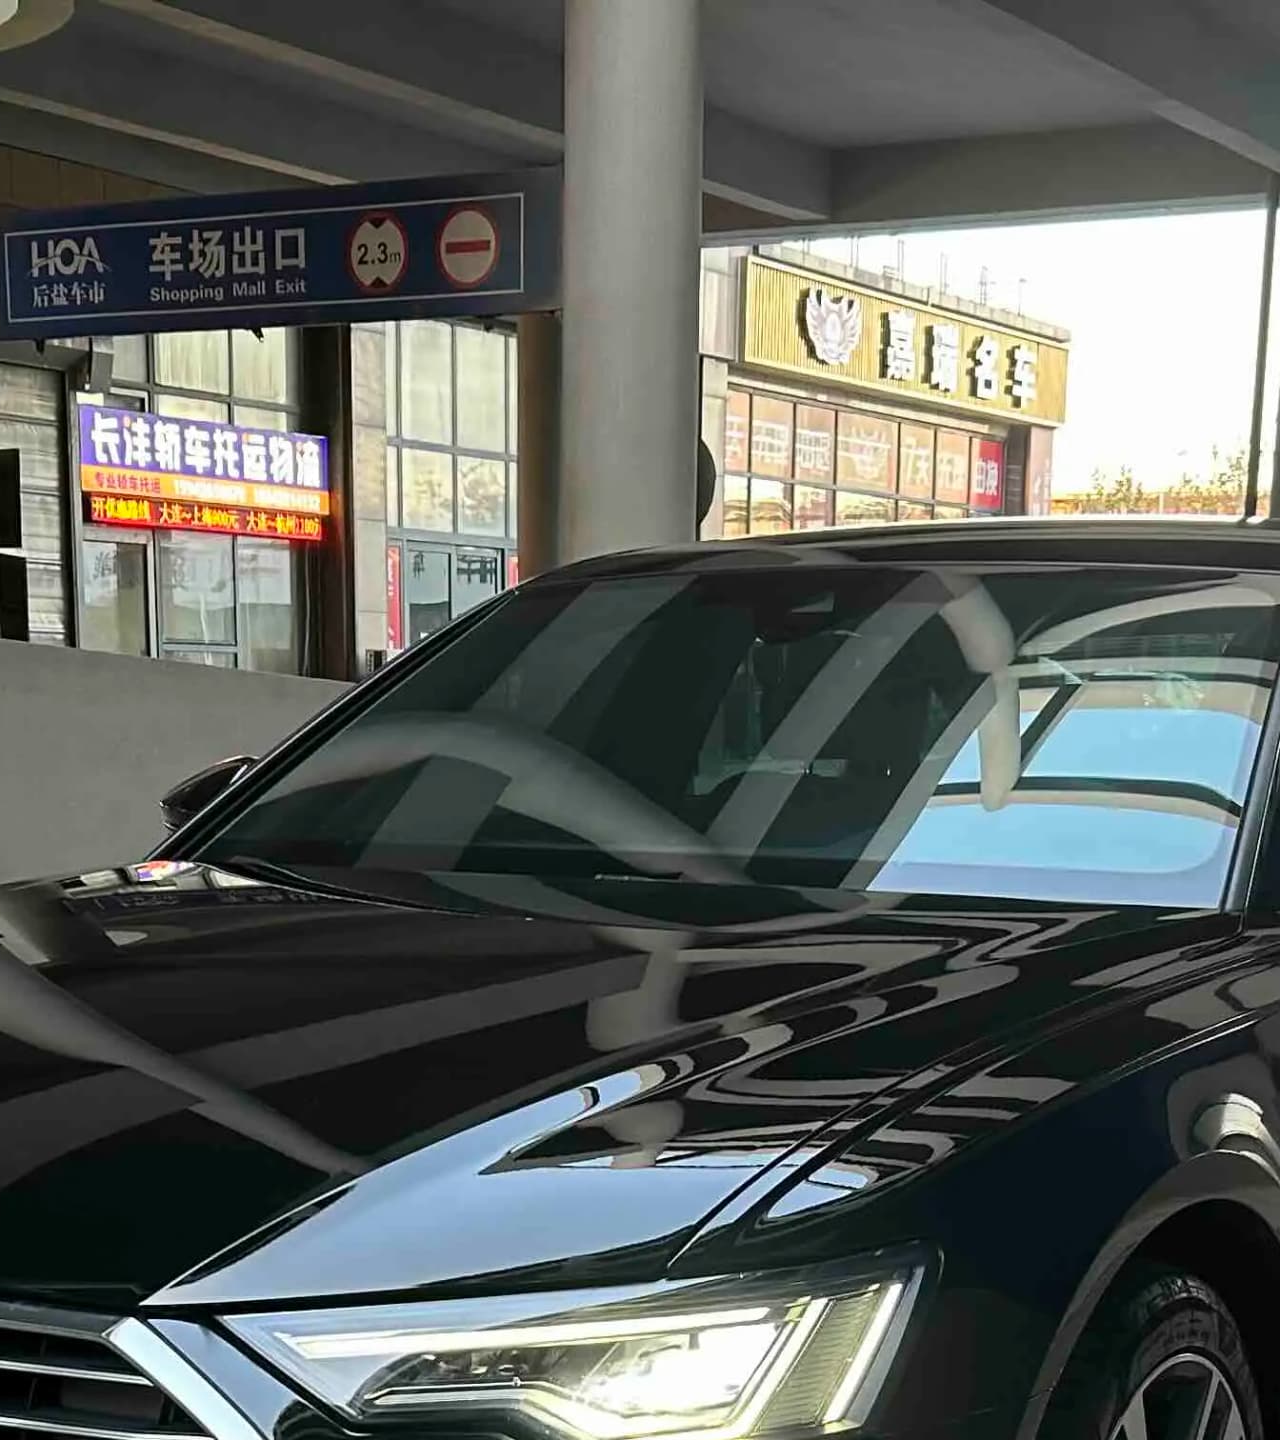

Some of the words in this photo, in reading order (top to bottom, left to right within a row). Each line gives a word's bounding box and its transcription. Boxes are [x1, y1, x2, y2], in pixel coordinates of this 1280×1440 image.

[29, 237, 106, 278] HOA
[149, 226, 307, 281] 车场出口
[150, 285, 224, 304] Shopping
[233, 281, 266, 297] Mall
[275, 278, 307, 294] Exit
